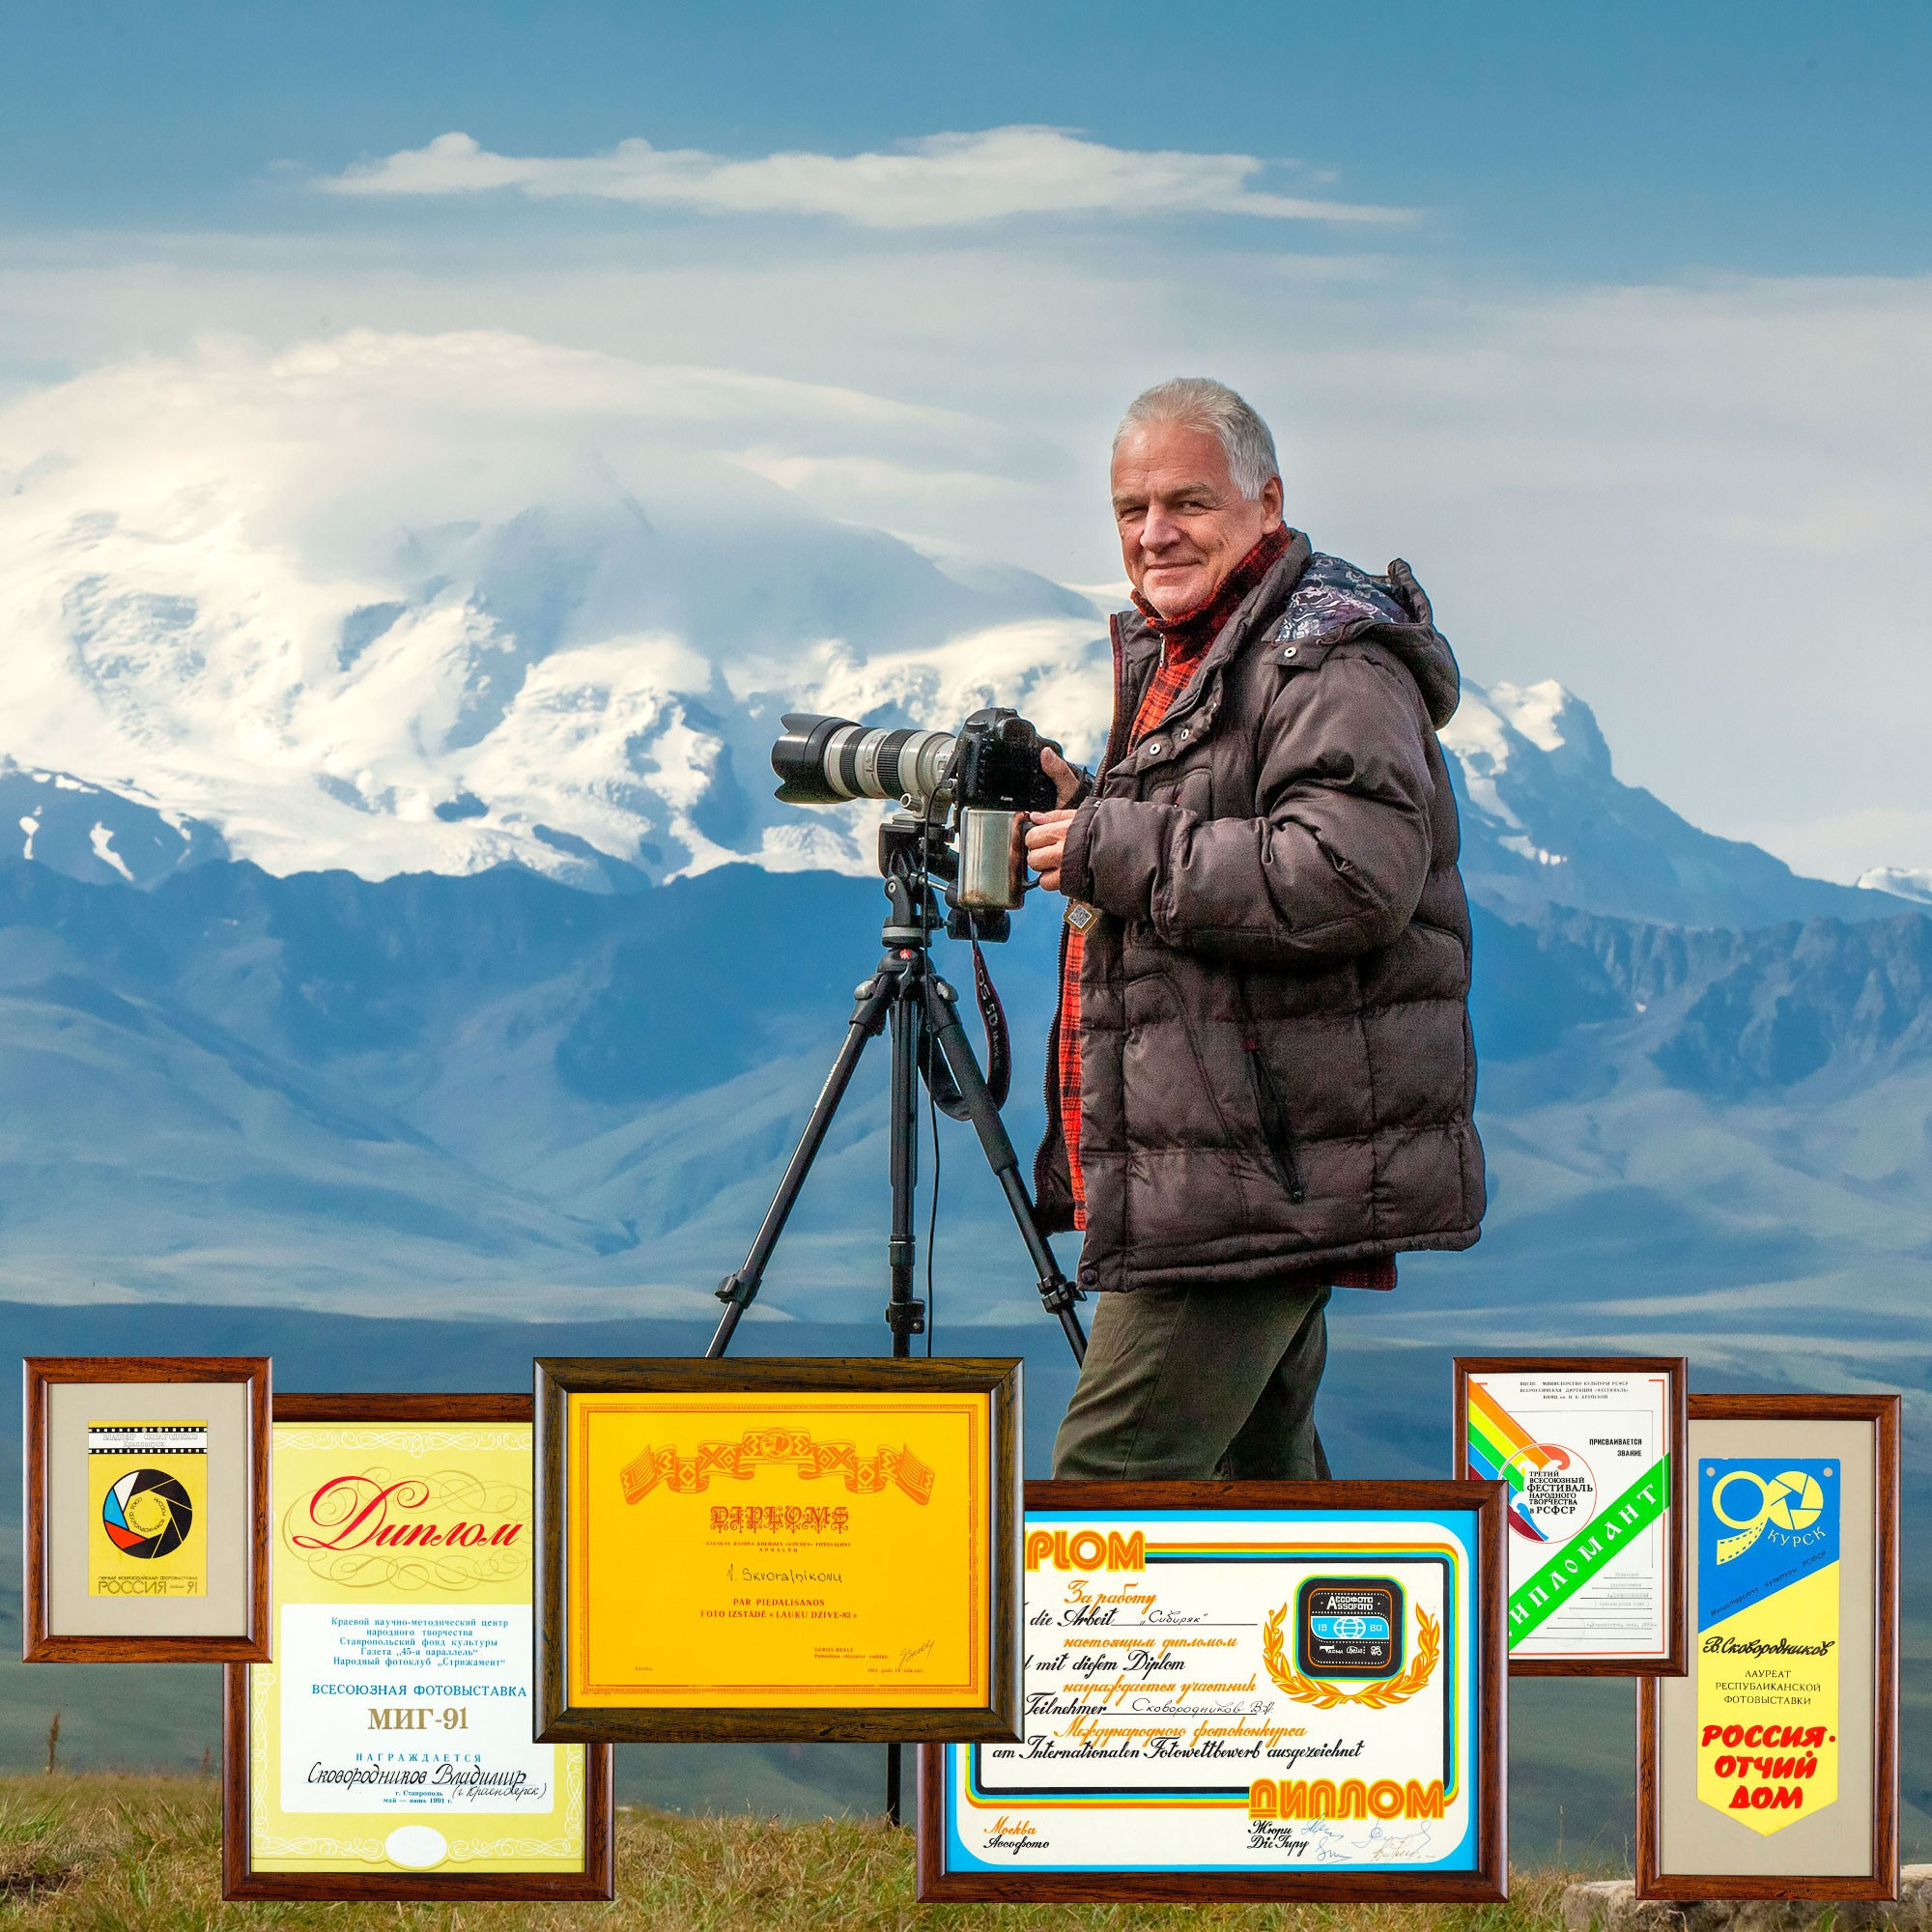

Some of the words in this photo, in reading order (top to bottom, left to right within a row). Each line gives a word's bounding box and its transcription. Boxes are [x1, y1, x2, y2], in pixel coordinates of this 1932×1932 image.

[1526, 1484, 1594, 1492] ФЕСТИВАЛЬ
[292, 1475, 524, 1550] Диплом
[710, 1505, 850, 1534] DIPLOMS
[1536, 1506, 1577, 1515] РСФСР
[1767, 1526, 1827, 1548] КУРСК
[1025, 1529, 1146, 1572] PLOM
[1509, 1484, 1657, 1636] ИПЛОМАНТ
[1802, 1550, 1827, 1567] РСФСР
[99, 1580, 167, 1595] РОССИЯ
[1064, 1579, 1094, 1604] За
[1089, 1582, 1156, 1614] работу
[733, 1598, 752, 1606] PAR
[331, 1616, 370, 1627] Краевой
[374, 1618, 476, 1628] научно-методический
[481, 1620, 509, 1629] центр
[1030, 1609, 1054, 1627] die
[1057, 1605, 1119, 1627] Arbeit
[366, 1629, 415, 1637] народного
[1370, 1624, 1382, 1633] 80
[339, 1637, 415, 1647] Ставропольский
[421, 1637, 446, 1648] фонд
[451, 1639, 498, 1648] культуры
[360, 1647, 392, 1656] Газета
[1063, 1638, 1156, 1651] настоящим
[1156, 1636, 1238, 1659] дипломом
[333, 1657, 381, 1666] Народный
[384, 1657, 432, 1667] фотоклуб
[1037, 1653, 1069, 1670] mit
[1122, 1649, 1186, 1680] Diplom
[1745, 1669, 1792, 1678] ЛАУРЕАТ
[311, 1684, 408, 1695] ВСЕСОЮЗНАЯ
[413, 1685, 527, 1697] ФОТОВЫСТАВКА
[1063, 1674, 1177, 1707] награждается
[1176, 1673, 1257, 1704] участник
[1716, 1682, 1822, 1692] РЕСПУБЛИКАНСКОЙ
[1024, 1691, 1107, 1716] Teilnehmer
[1723, 1695, 1811, 1705] ФОТОВЫСТАВКИ
[367, 1707, 469, 1730] МИГ-91
[1053, 1715, 1186, 1747] Международного
[1189, 1716, 1308, 1748] фотоконкурса
[355, 1752, 482, 1763] НАГРАЖДАЕТСЯ
[992, 1749, 1016, 1759] am
[1018, 1735, 1140, 1759] Internationalen
[1143, 1737, 1263, 1759] Fotowettbewerb
[1266, 1739, 1366, 1770] ausgezeichnet
[1714, 1750, 1818, 1779] ОТЧИЙ
[307, 1761, 428, 1791] Сковородников
[431, 1763, 527, 1787] Владимир
[1248, 1777, 1445, 1820] ДИПЛОМ
[1728, 1785, 1804, 1809] ДОМ
[983, 1815, 1037, 1835] Москва
[1247, 1820, 1293, 1840] Жюри
[982, 1833, 1050, 1857] Ассофото
[1247, 1835, 1273, 1849] Die
